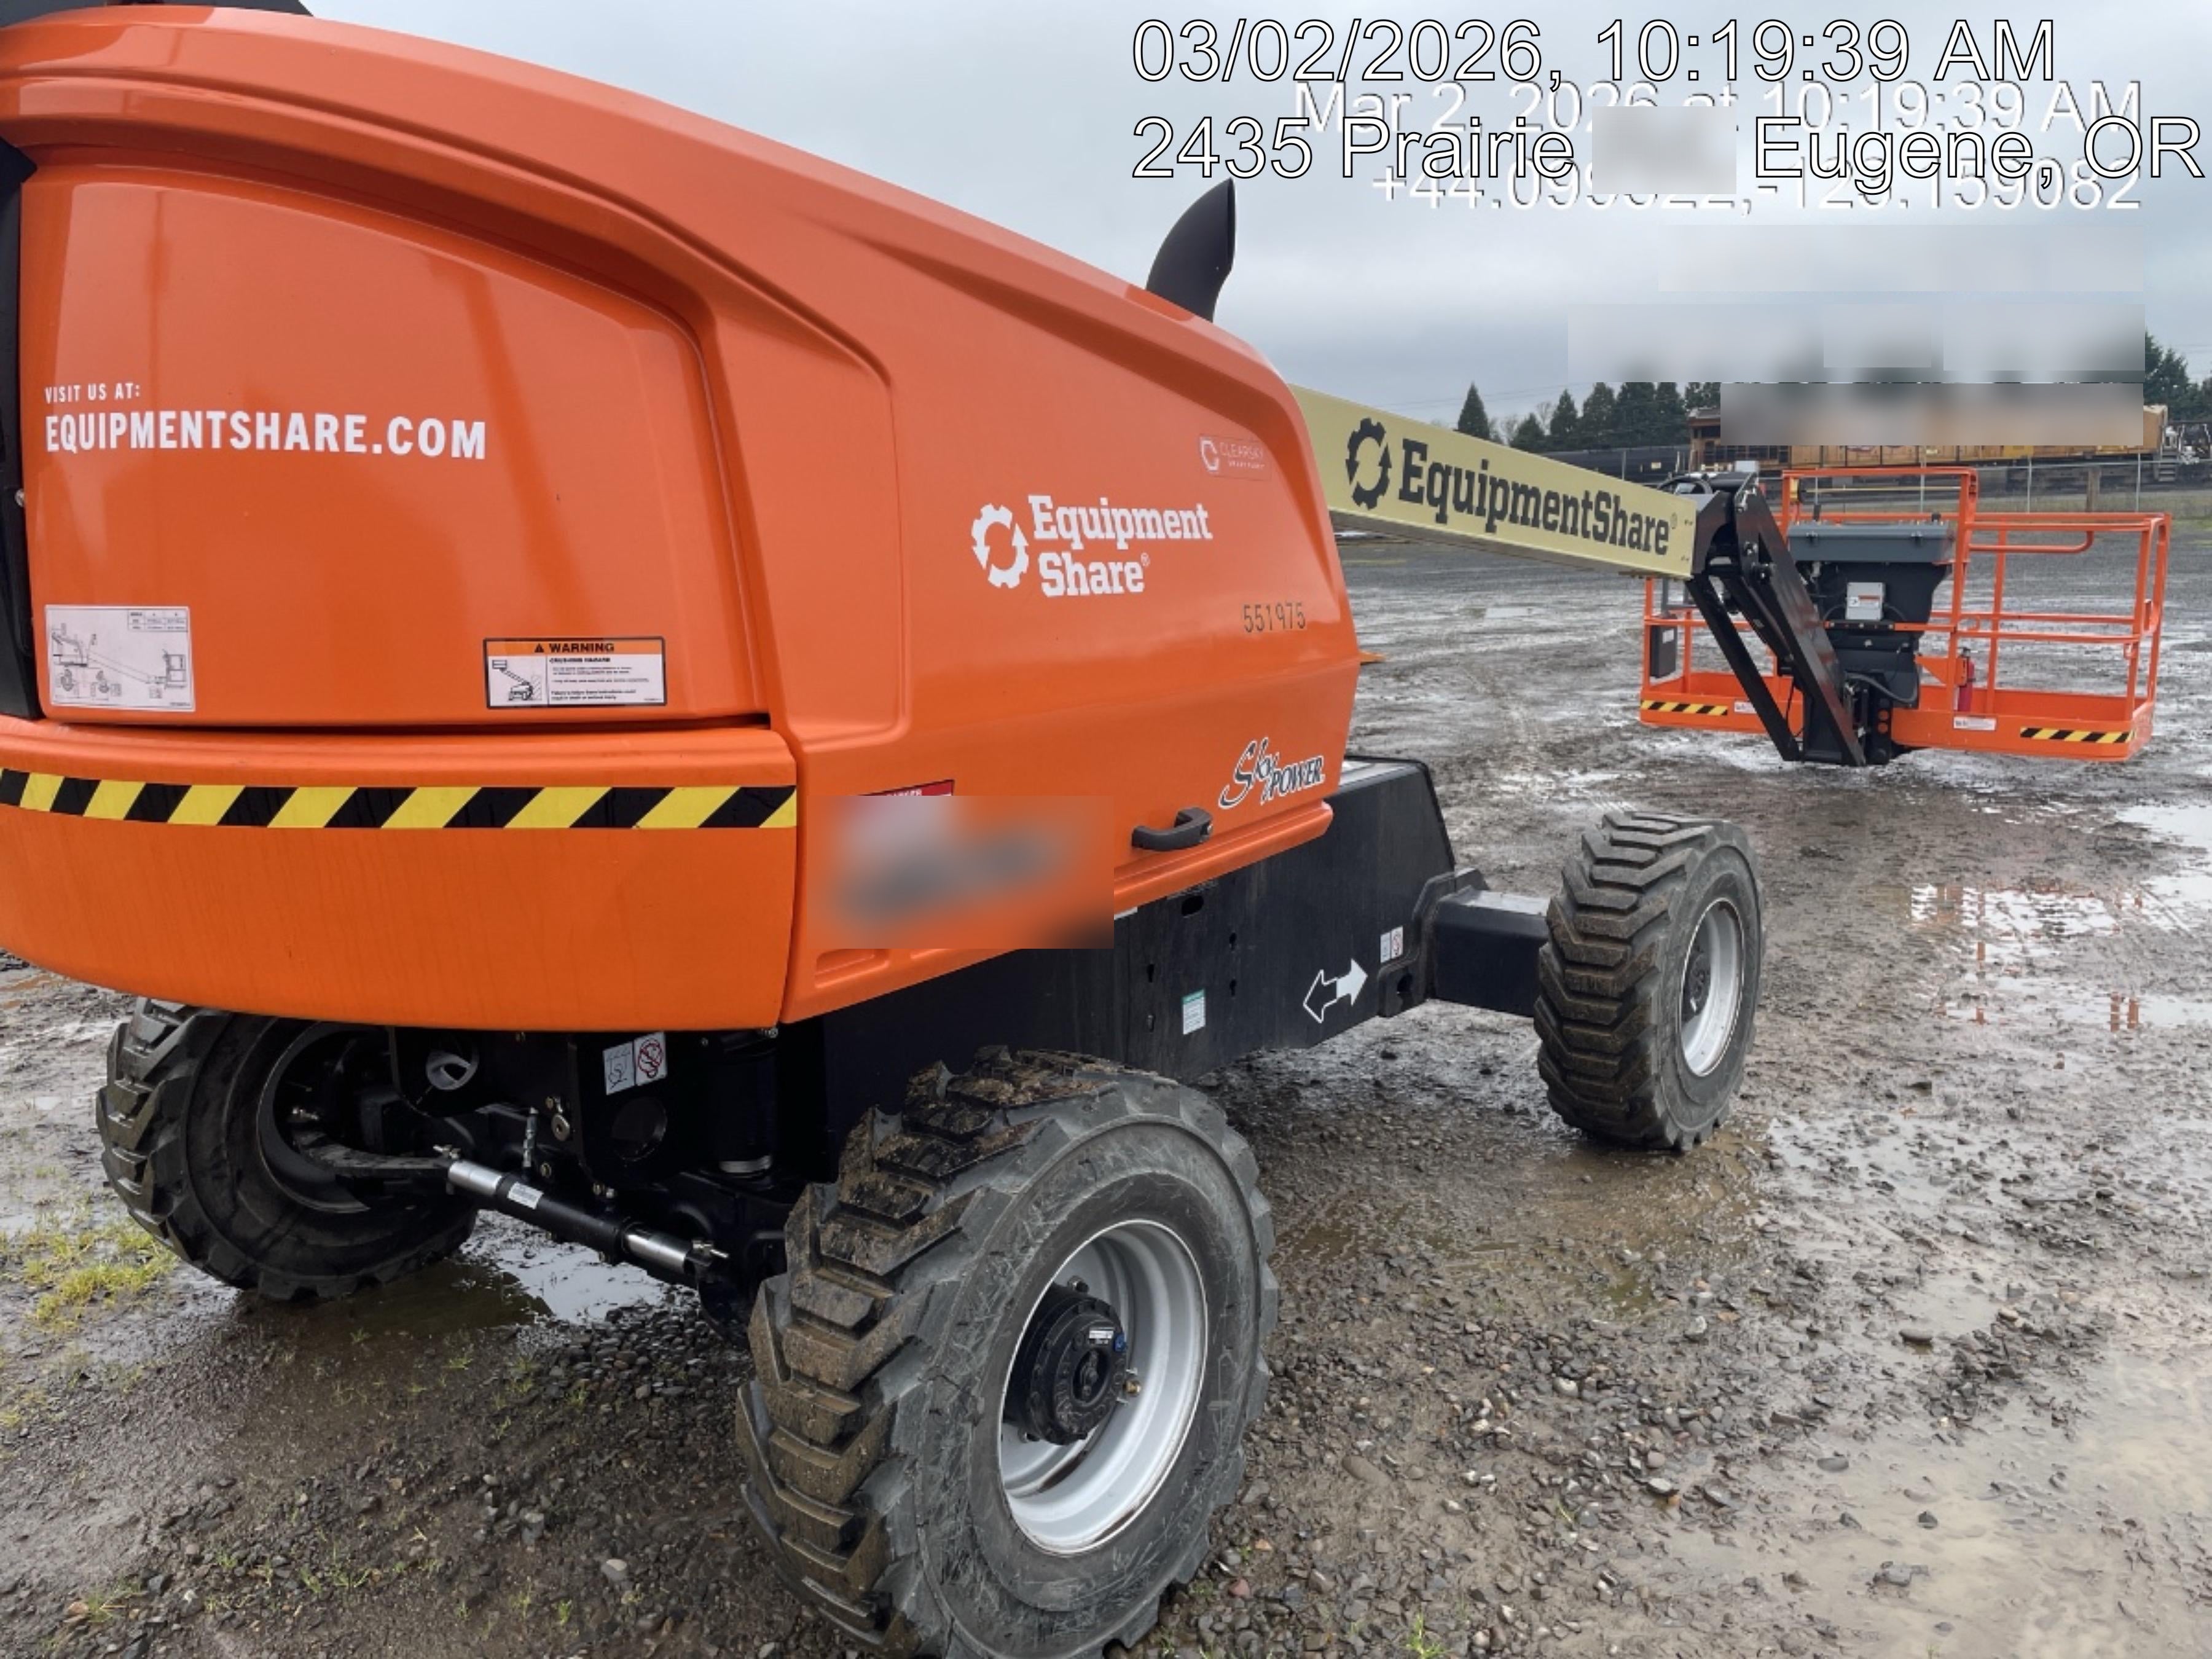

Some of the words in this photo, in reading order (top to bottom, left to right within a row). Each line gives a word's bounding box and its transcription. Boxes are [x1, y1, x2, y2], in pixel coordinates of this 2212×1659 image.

[45, 385, 80, 404] VISIT
[88, 383, 106, 401] US
[115, 382, 140, 400] AT:
[45, 410, 485, 460] EQUIPMENTSHARE.COM
[1028, 495, 1212, 549] Equipment
[1243, 602, 1306, 633] 551975
[549, 643, 614, 653] WARNING
